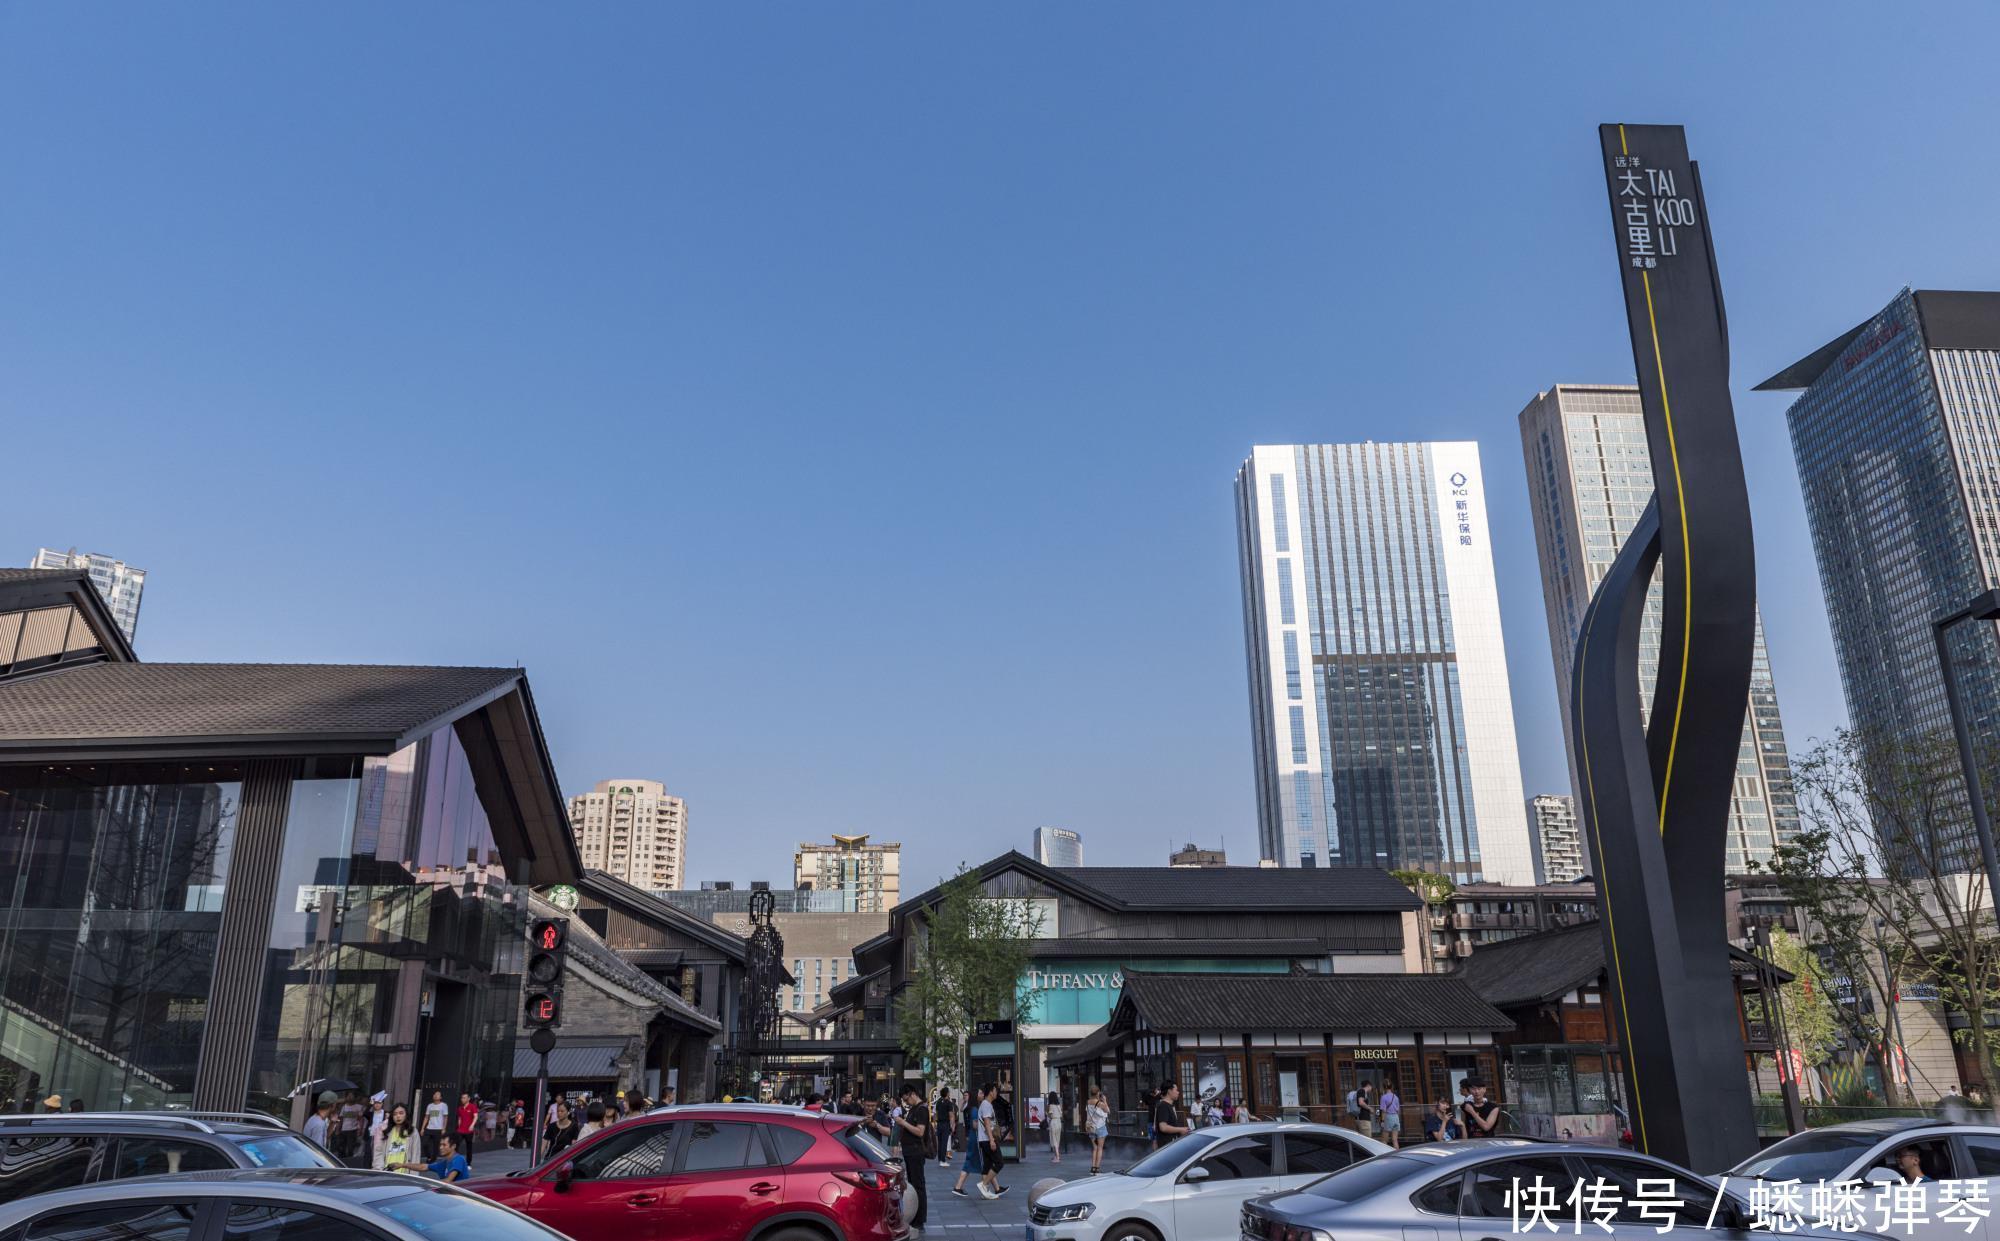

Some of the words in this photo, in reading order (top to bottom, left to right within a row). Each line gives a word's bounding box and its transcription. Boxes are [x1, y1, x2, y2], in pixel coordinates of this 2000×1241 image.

[1645, 169, 1677, 197] TAI
[1618, 169, 1655, 256] 太古里
[1653, 198, 1695, 226] KOO
[1658, 227, 1677, 256] LI
[1632, 257, 1656, 269] 成都
[1455, 500, 1472, 546] 新华保险
[1027, 970, 1108, 989] TIFFANY
[1110, 971, 1124, 989] &
[540, 1000, 553, 1019] 12
[1353, 1049, 1399, 1059] BREGUET
